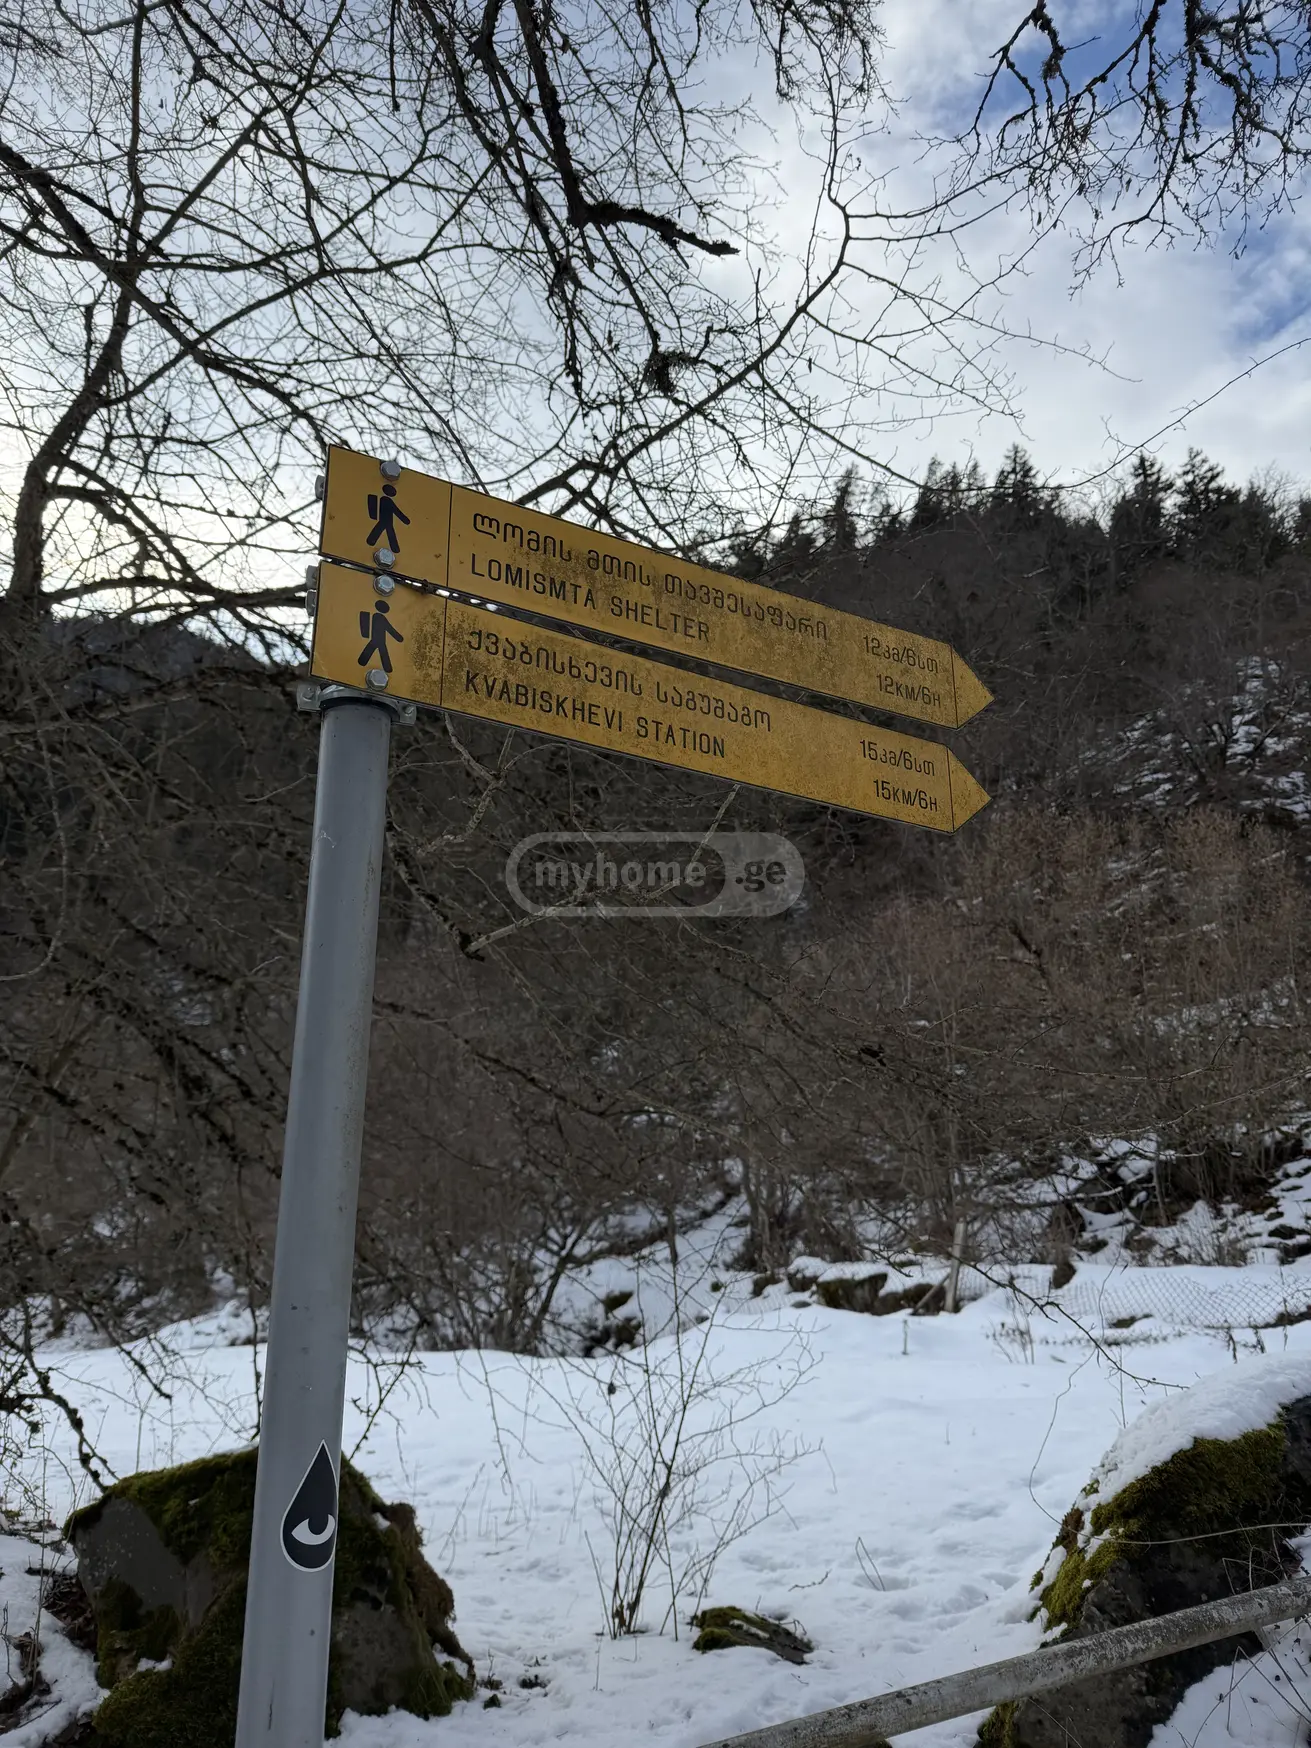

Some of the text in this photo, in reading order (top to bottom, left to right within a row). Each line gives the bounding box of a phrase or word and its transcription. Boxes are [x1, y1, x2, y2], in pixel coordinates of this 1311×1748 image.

[471, 552, 710, 643] LOMISMTA SHELTER
[473, 512, 828, 641] ლომის მთის თავშესაფარი
[465, 669, 726, 759] KVABISKHEVI STATION
[467, 629, 771, 733] ქვაბისხევის საგუშაგო
